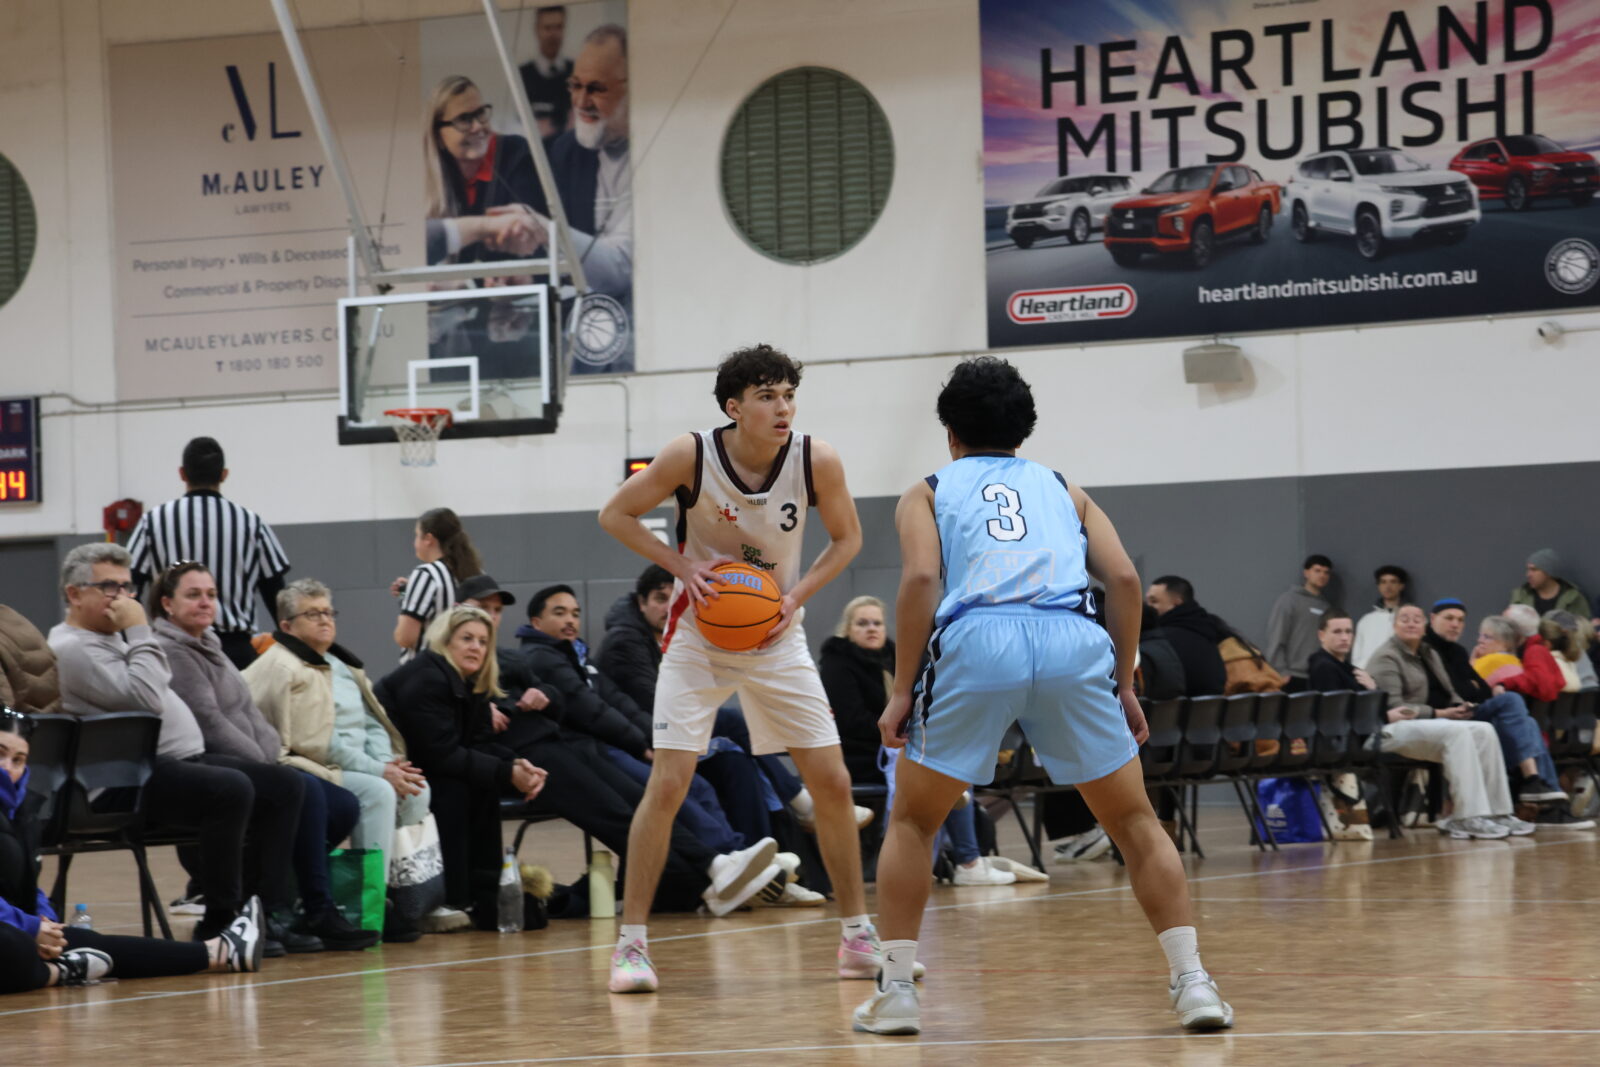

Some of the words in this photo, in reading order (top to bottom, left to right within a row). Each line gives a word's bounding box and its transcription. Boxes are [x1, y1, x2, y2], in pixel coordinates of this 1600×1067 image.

[1040, 0, 1555, 108] HEARTLAND
[1056, 70, 1535, 177] MITSUBISHI
[202, 165, 324, 196] McAULEY
[234, 202, 292, 215] LAWYERS
[132, 255, 188, 272] Personal
[190, 254, 225, 271] Injury
[238, 251, 269, 265] Wills
[271, 251, 282, 264] &
[163, 281, 239, 299] Commercial
[242, 280, 253, 293] &
[256, 276, 309, 294] Property
[1198, 268, 1478, 304] heartlandmitsubishi.com.au
[1019, 291, 1125, 315] Heartland
[216, 360, 224, 373] T
[229, 358, 262, 372] 1800
[267, 356, 290, 370] 180
[296, 354, 324, 369] 500
[780, 502, 798, 532] 3
[980, 482, 1028, 542] 3
[743, 550, 778, 570] Super
